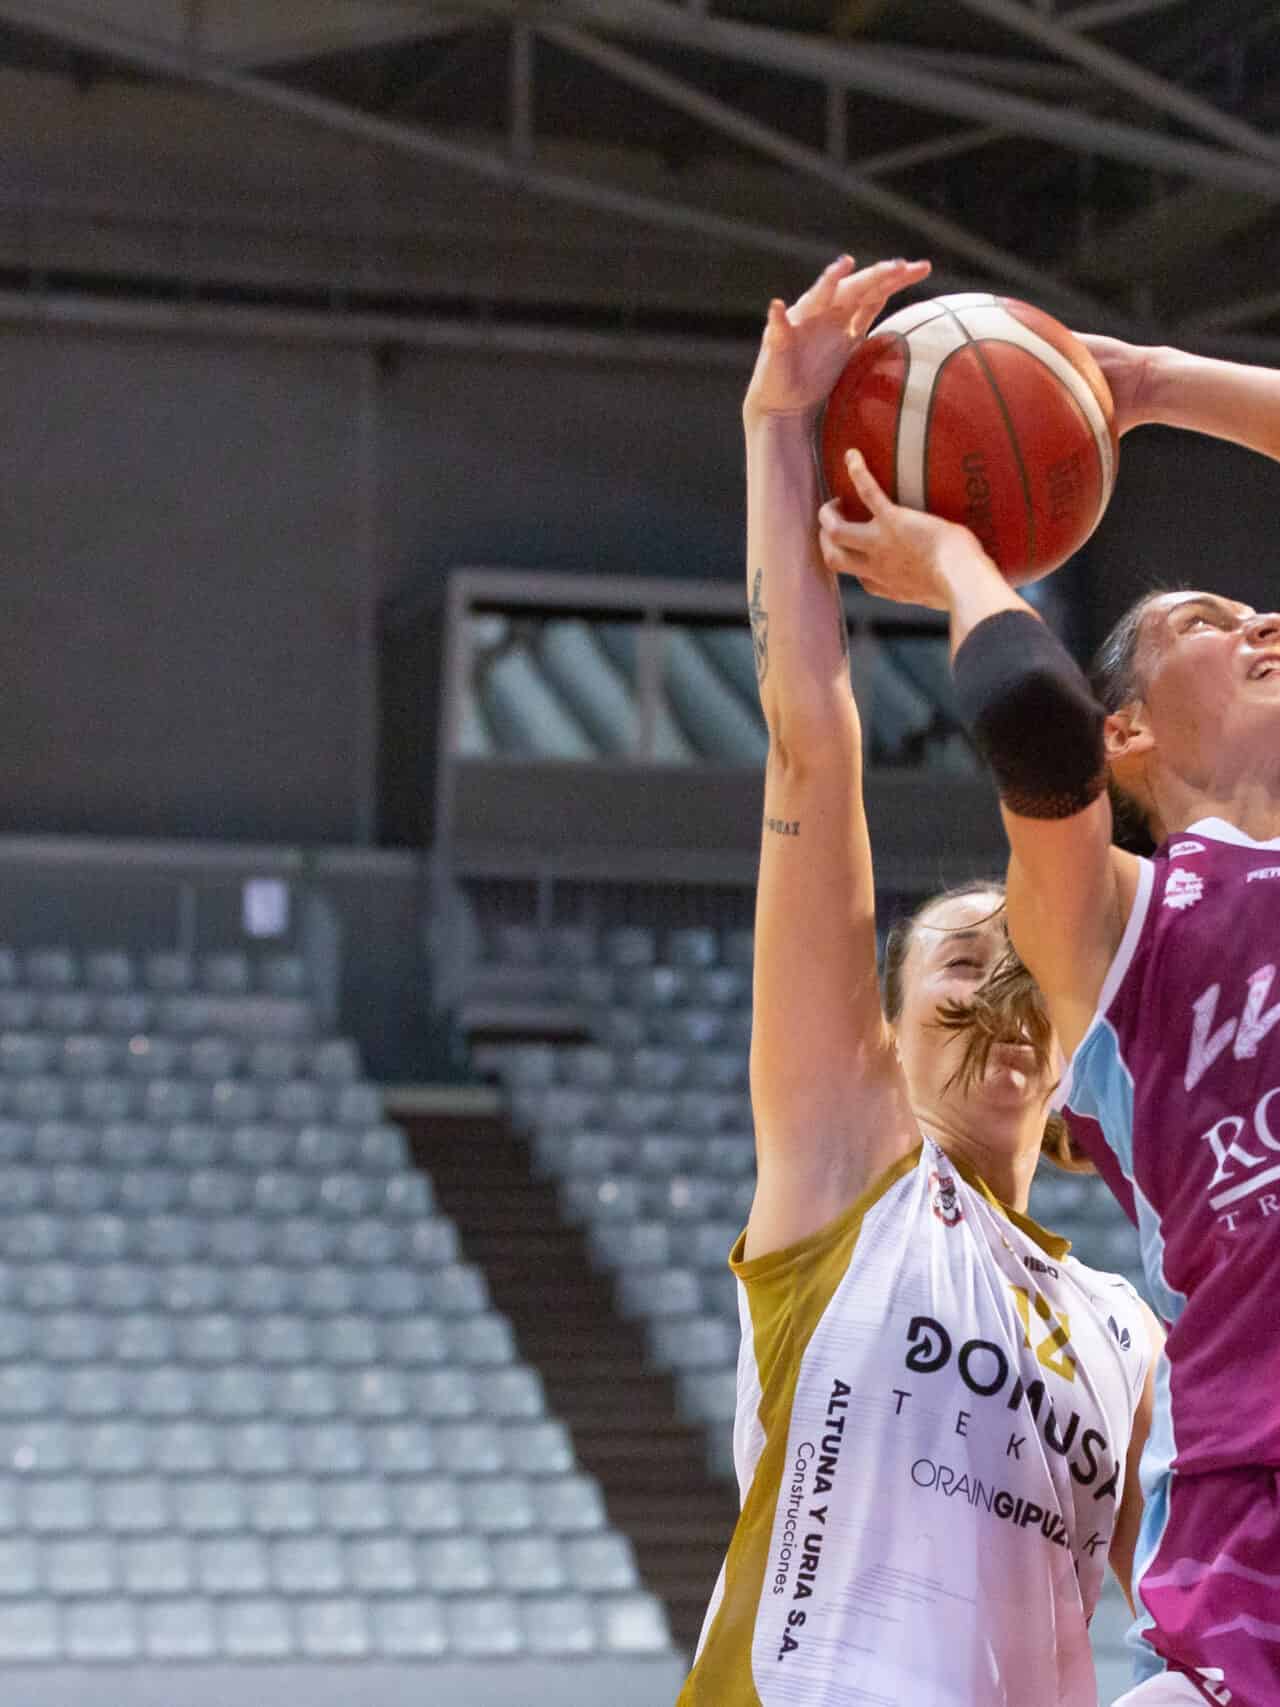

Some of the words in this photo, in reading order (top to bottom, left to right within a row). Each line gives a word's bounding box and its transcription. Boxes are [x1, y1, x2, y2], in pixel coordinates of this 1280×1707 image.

[812, 1379, 851, 1494] ALTUNA
[773, 1442, 815, 1595] Construcciones
[808, 1505, 828, 1525] Y
[793, 1533, 823, 1600] URIA
[778, 1609, 807, 1662] S.A.
